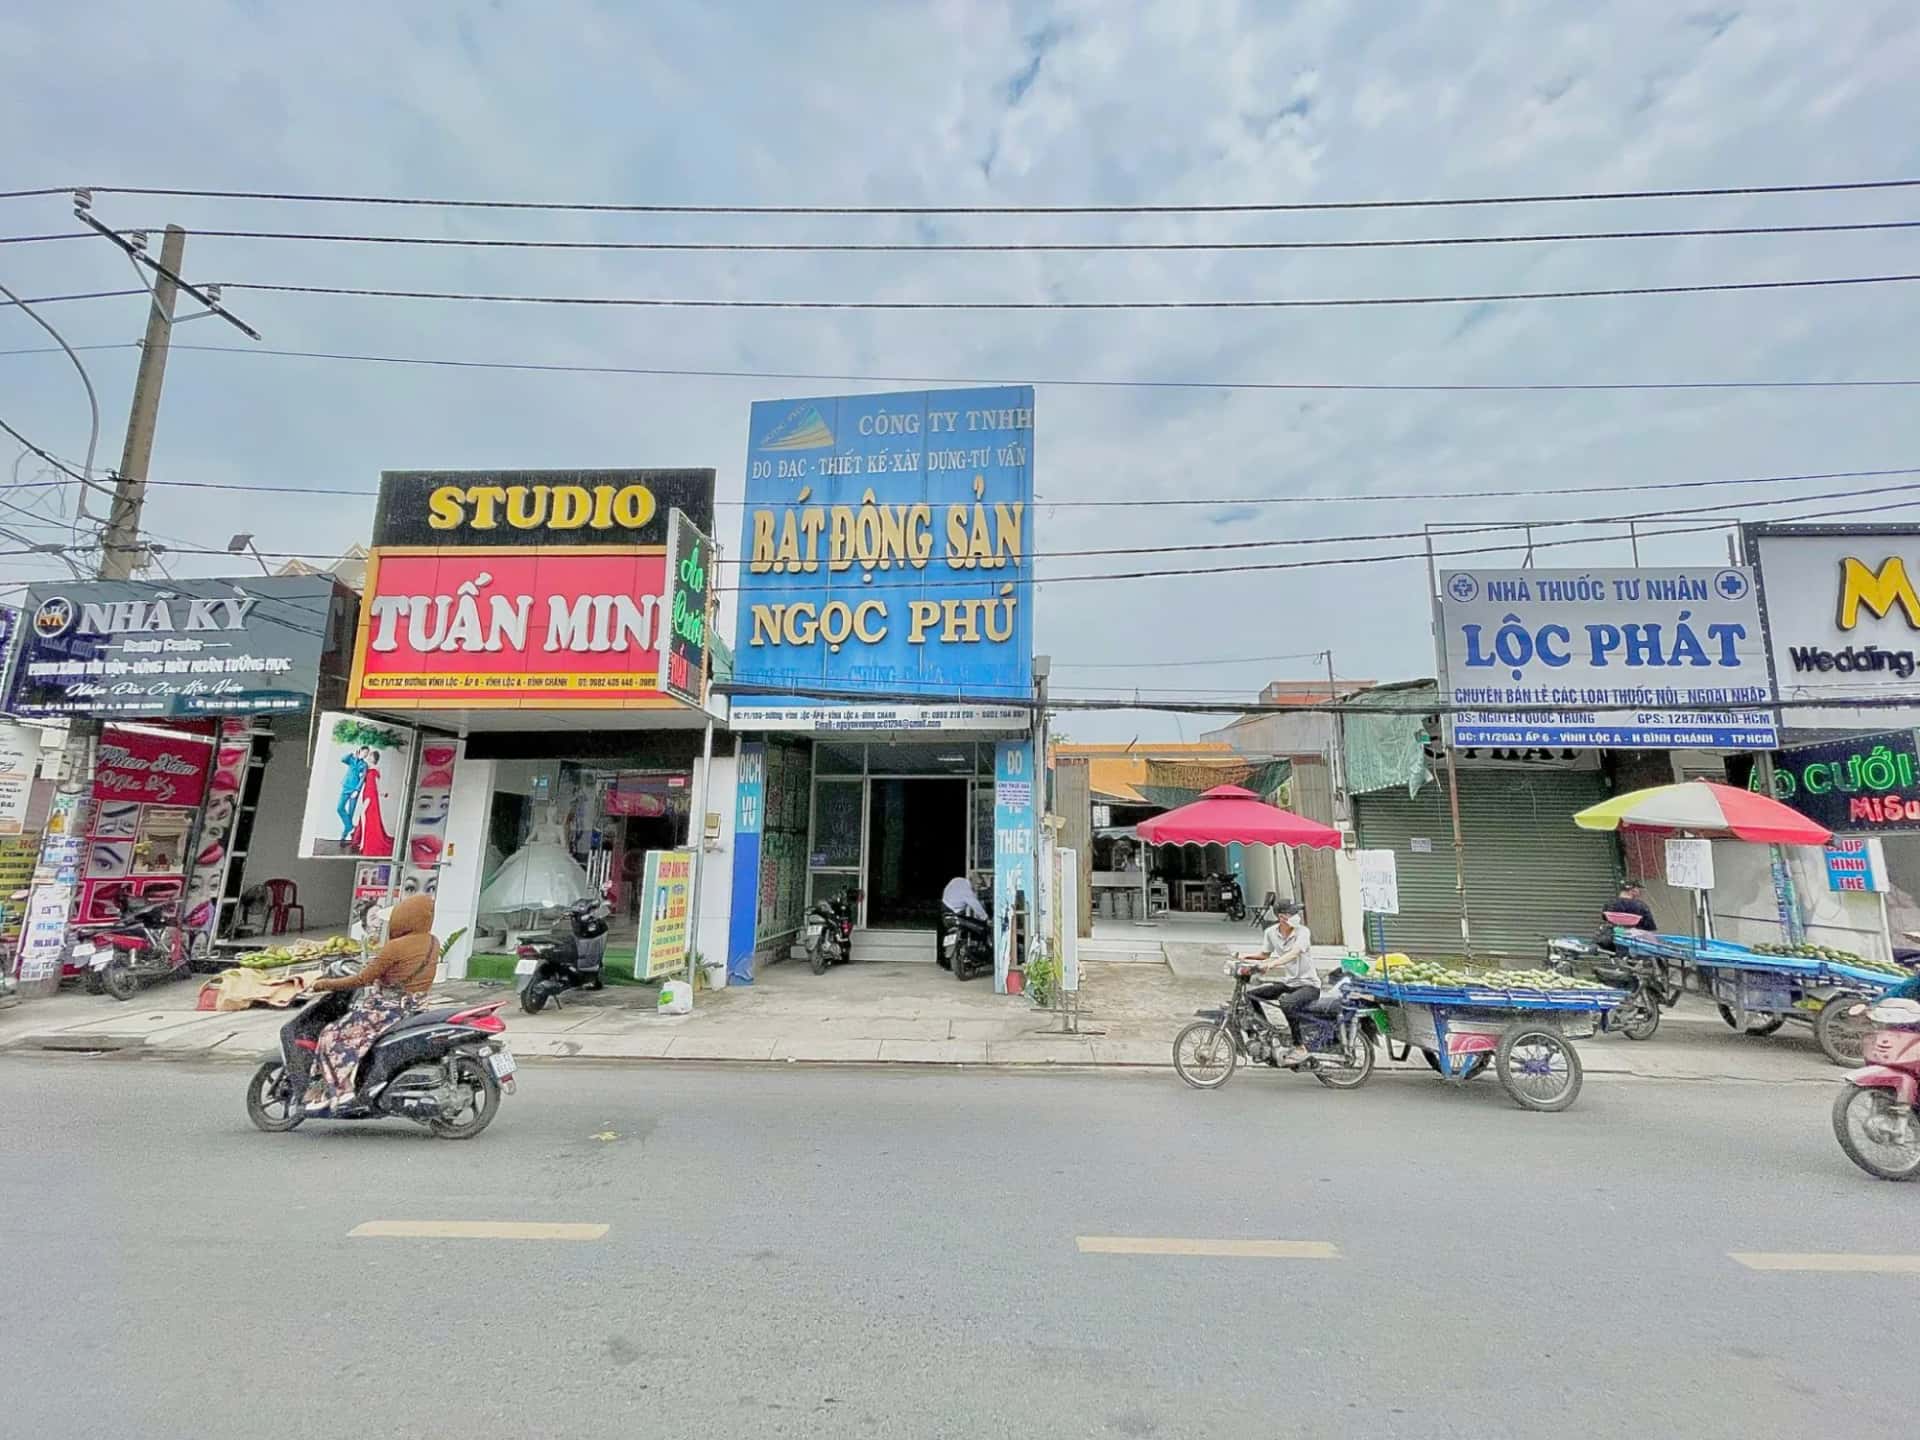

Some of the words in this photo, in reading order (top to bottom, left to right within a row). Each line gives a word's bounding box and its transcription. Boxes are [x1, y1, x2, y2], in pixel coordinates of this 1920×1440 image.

[859, 409, 920, 435] CÔNG
[928, 412, 960, 433] TY
[960, 407, 1033, 431] TNHH
[752, 459, 772, 480] ĐO
[778, 458, 808, 482] ĐẠC
[818, 448, 863, 475] THIẾT
[997, 440, 1027, 467] VẤN
[428, 484, 657, 530] STUDIO
[829, 487, 933, 583] ĐỘNG
[945, 474, 1025, 570] SẢN
[1487, 577, 1531, 601] NHÀ
[1536, 574, 1605, 601] THUỐC
[1612, 577, 1640, 601] TƯ
[1646, 574, 1708, 601] NHÂN
[76, 591, 176, 634] NHÃ
[370, 571, 534, 652] TUẤN
[543, 594, 666, 653] MIN
[750, 600, 888, 653] NGỌC
[907, 583, 1017, 644] PHÚ
[1461, 613, 1571, 682] LỘC
[1584, 610, 1747, 668] PHÁT
[1789, 645, 1914, 678] Wedding
[1506, 685, 1532, 703] BÁN
[1612, 684, 1653, 704] THUỐC
[1560, 730, 1586, 743] VĨNH
[1589, 732, 1610, 745] LỘC
[1613, 734, 1622, 743] A
[1643, 732, 1671, 743] BÌNH
[1674, 731, 1714, 744] CHÁNH
[1803, 746, 1914, 795] CƯỚI
